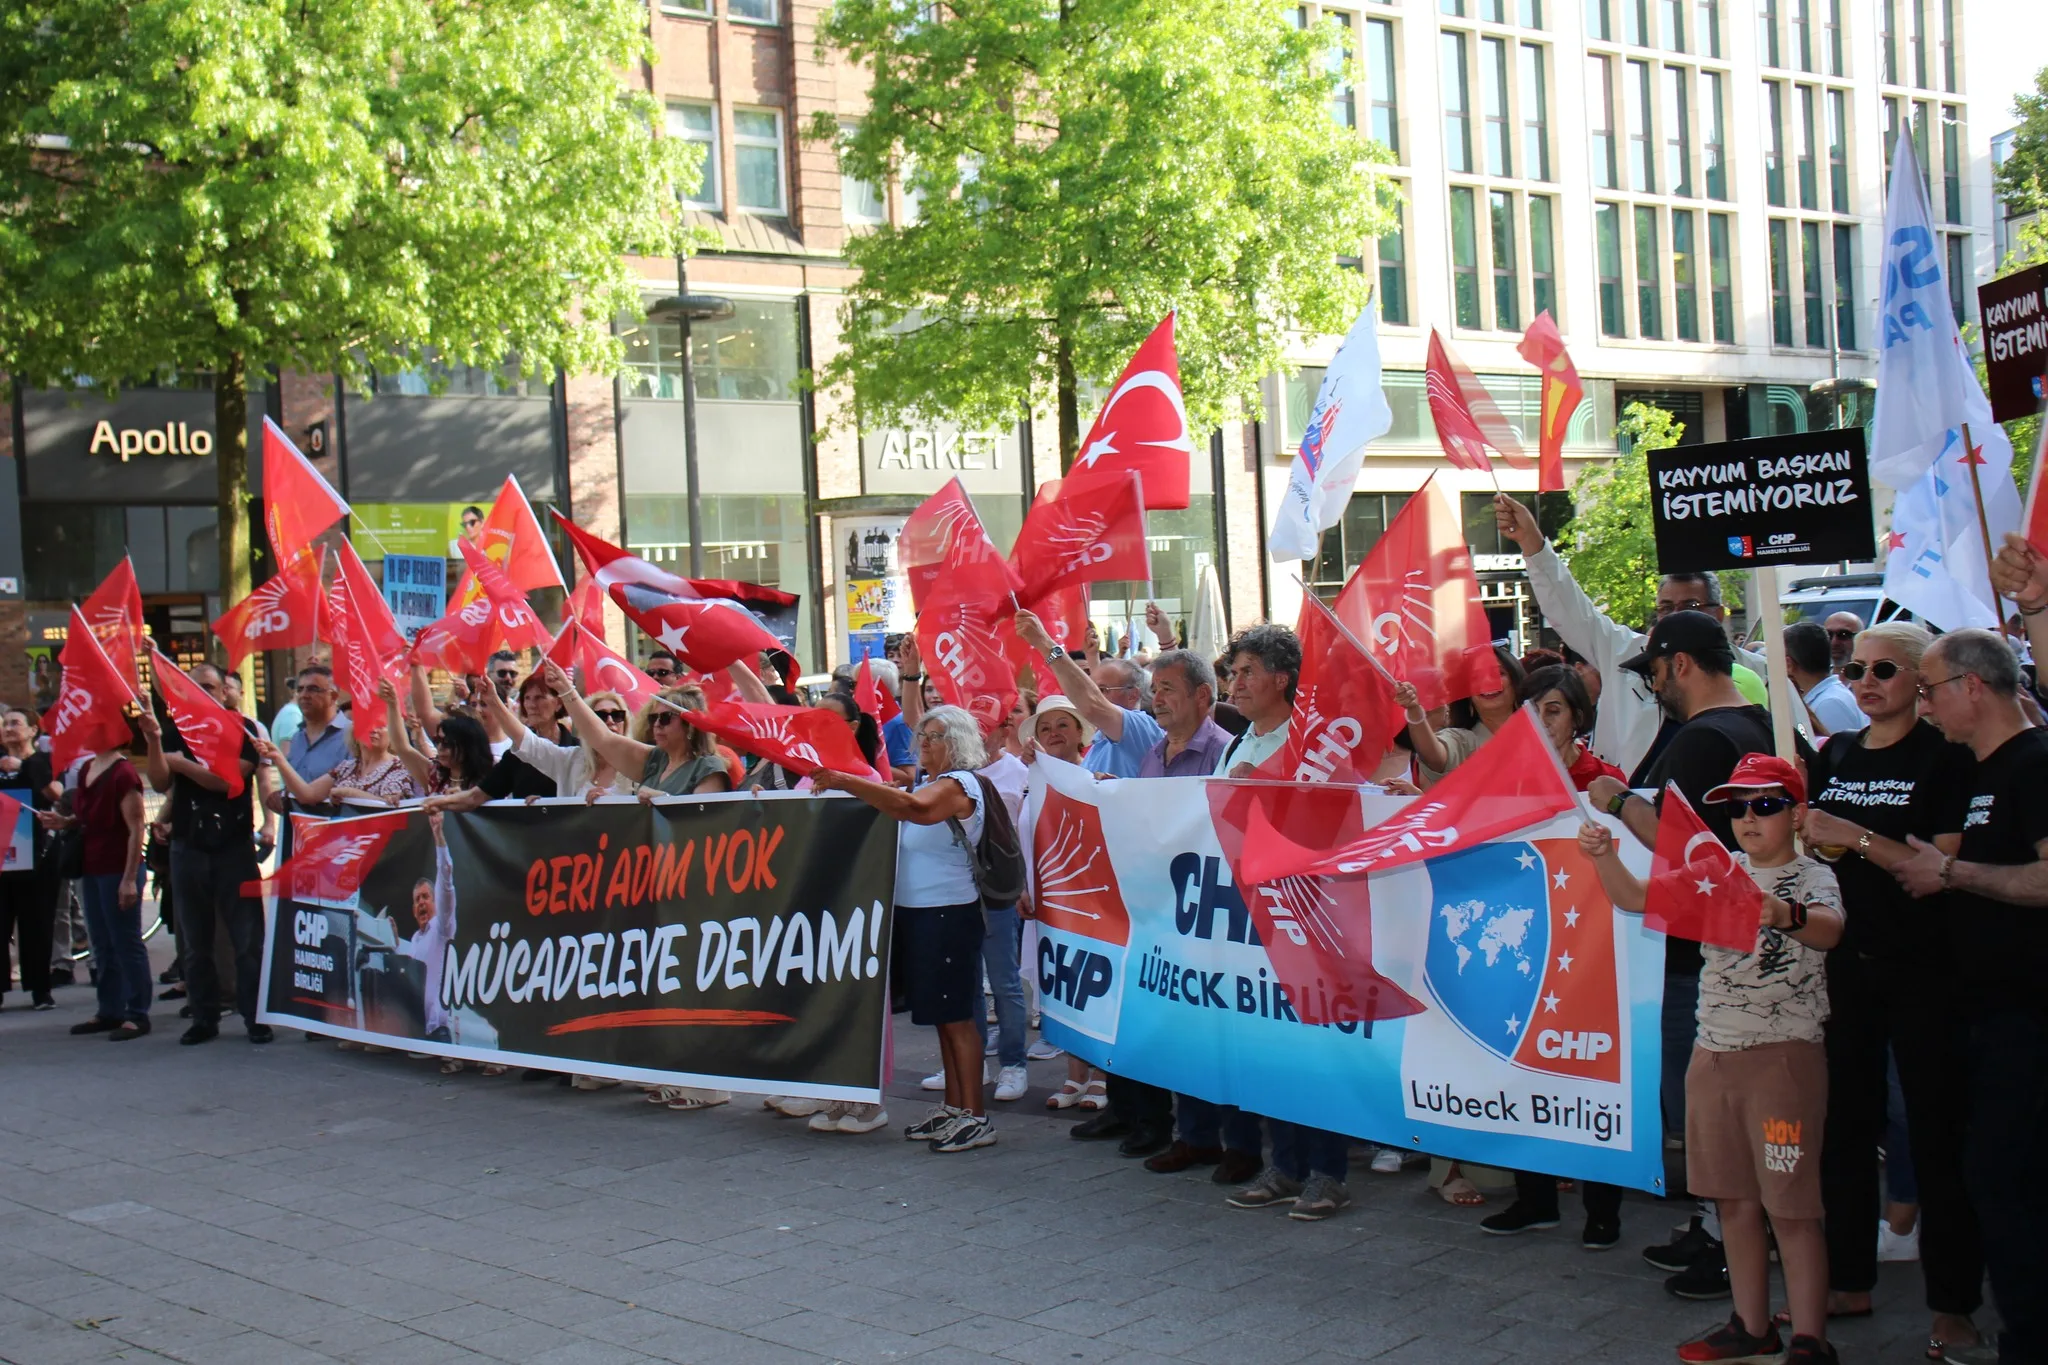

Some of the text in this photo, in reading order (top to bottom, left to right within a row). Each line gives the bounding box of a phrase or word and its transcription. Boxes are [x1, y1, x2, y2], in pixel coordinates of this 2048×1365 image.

[1986, 291, 2040, 328] KAYYUM
[1990, 314, 2048, 362] İSTEMİ
[90, 420, 213, 462] Apollo
[880, 430, 1011, 470] ARKET
[1659, 450, 1851, 489] KAYYUM BAŞKAN
[1663, 478, 1858, 520] İSTEMİYORUZ
[1756, 547, 1788, 556] HAMBURG
[1768, 533, 1796, 545] CHP
[935, 631, 986, 688] CHP
[526, 824, 785, 917] GERİ ADIM YOK
[1169, 851, 1264, 947] CH
[1256, 877, 1308, 946] HP
[294, 910, 328, 948] CHP
[294, 949, 334, 972] HAMBURG
[442, 899, 883, 1007] MÜCADELEYE DEVAM!
[1038, 935, 1112, 1012] CHP
[294, 970, 324, 994] BİRLİĞİ
[1138, 949, 1379, 1040] LÜBECK BİRLİĞİ
[1536, 1028, 1612, 1061] CHP
[1411, 1081, 1622, 1142] Lübeck Birliği
[1765, 1156, 1798, 1173] DAY
